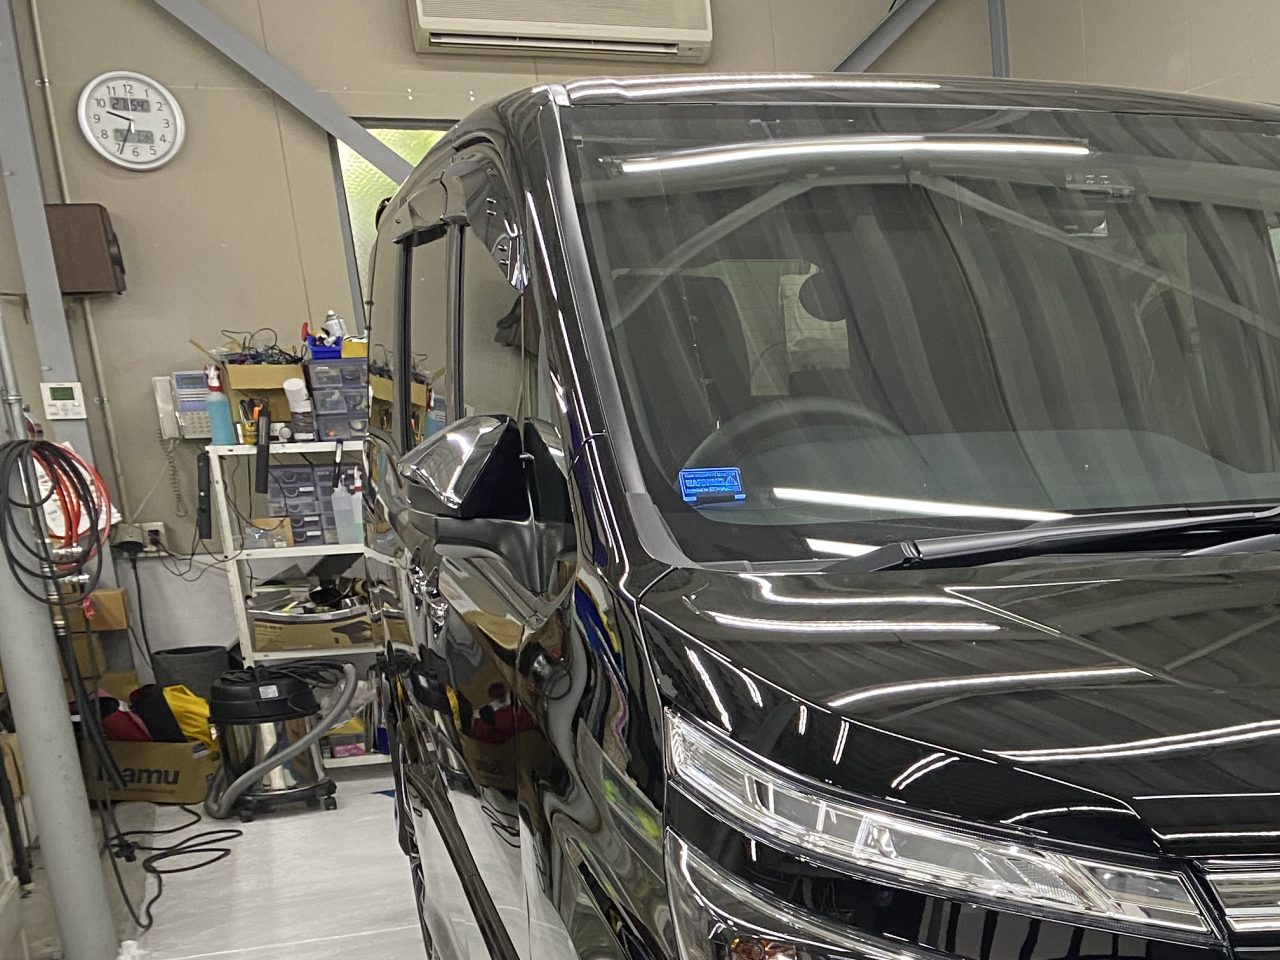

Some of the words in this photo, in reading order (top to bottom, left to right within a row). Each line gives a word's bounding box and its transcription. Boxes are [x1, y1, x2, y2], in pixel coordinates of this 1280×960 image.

[106, 85, 116, 96] 11
[123, 84, 133, 94] 12
[144, 89, 149, 98] 1
[95, 98, 106, 108] 10
[156, 101, 163, 111] 2
[93, 114, 101, 123] 9
[163, 118, 170, 128] 3
[101, 129, 108, 139] 8
[160, 134, 166, 143] 4
[115, 143, 121, 153] 7
[132, 147, 139, 157] 6
[149, 145, 157, 155] 5
